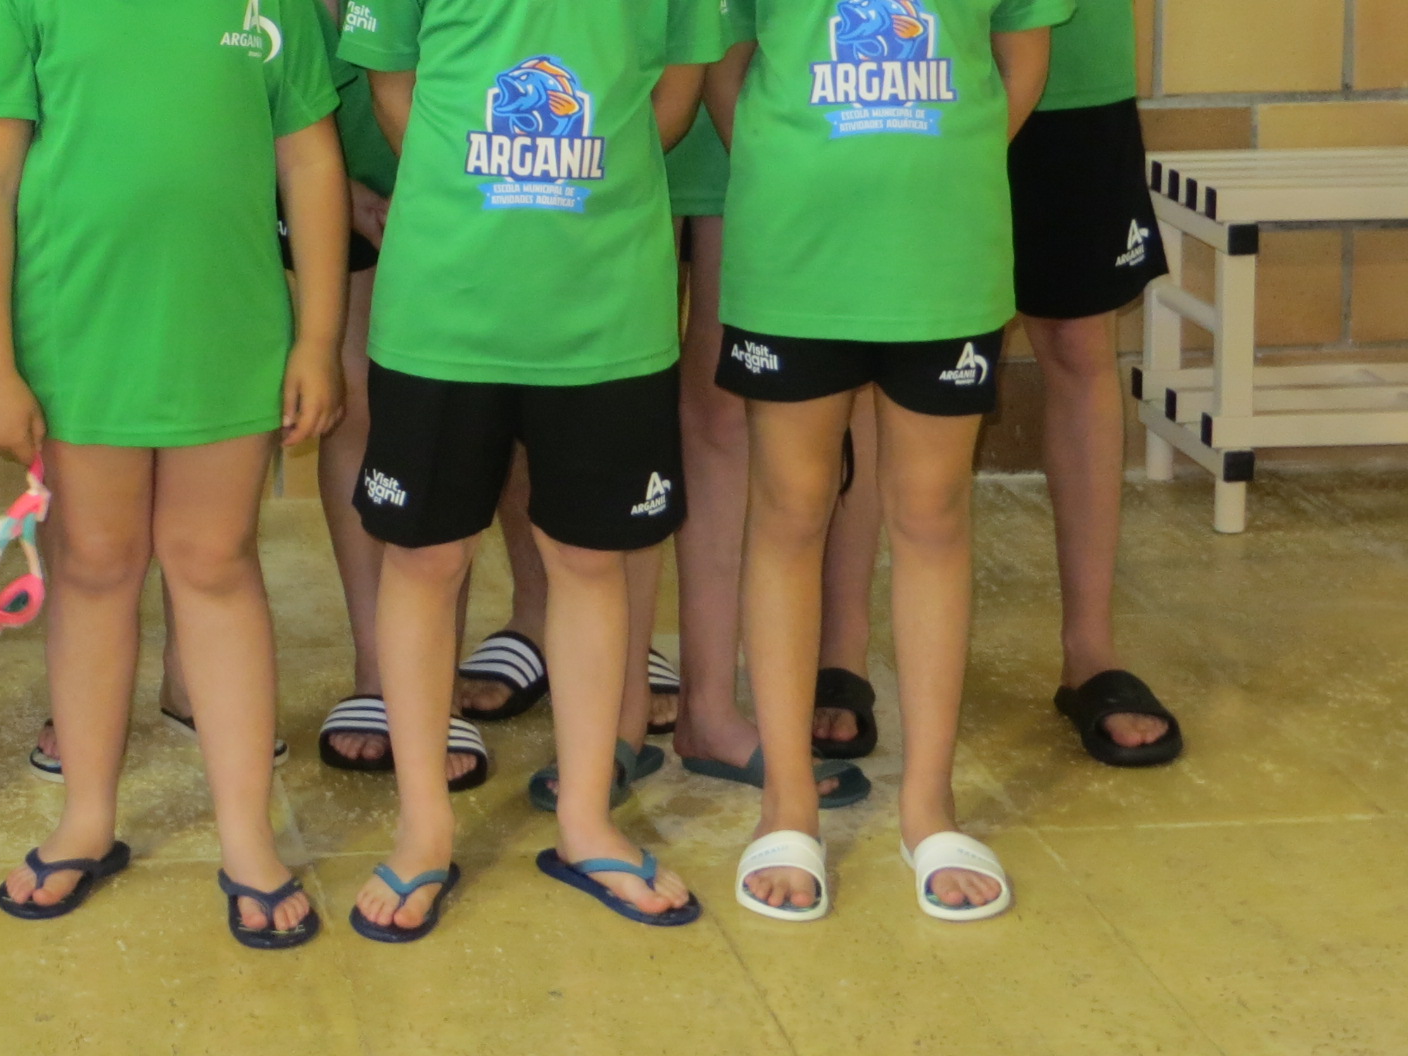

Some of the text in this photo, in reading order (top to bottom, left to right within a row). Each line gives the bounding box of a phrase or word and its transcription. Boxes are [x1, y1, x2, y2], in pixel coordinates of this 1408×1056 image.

[810, 60, 954, 104] ARGANIL
[466, 132, 603, 179] ARGANIL
[731, 343, 779, 371] Arganil
[744, 339, 770, 358] Visit
[372, 468, 400, 492] Visit
